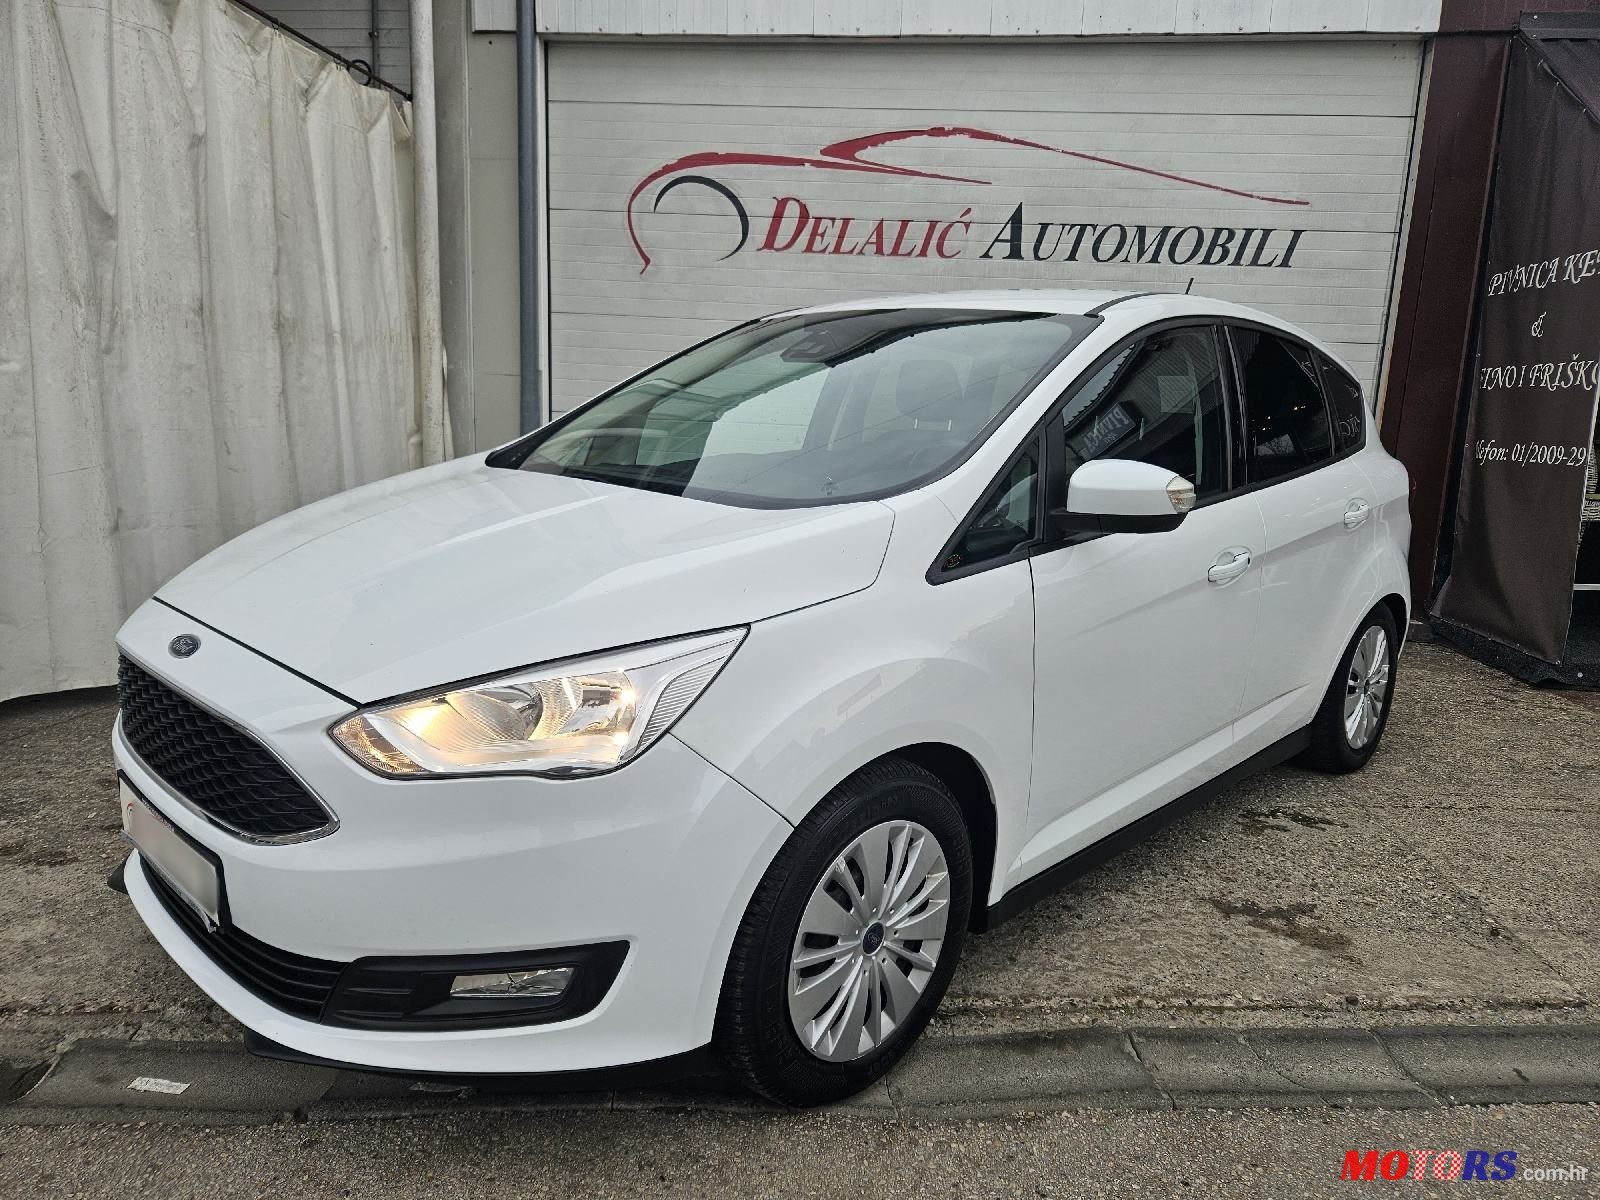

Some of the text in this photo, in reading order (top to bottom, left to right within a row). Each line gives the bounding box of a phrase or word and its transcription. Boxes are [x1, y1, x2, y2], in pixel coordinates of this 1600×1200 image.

[757, 196, 1304, 269] DELALIĆ AUTOMOBILI
[1562, 249, 1600, 284] KE
[1531, 312, 1547, 338] &
[1479, 365, 1517, 390] INO
